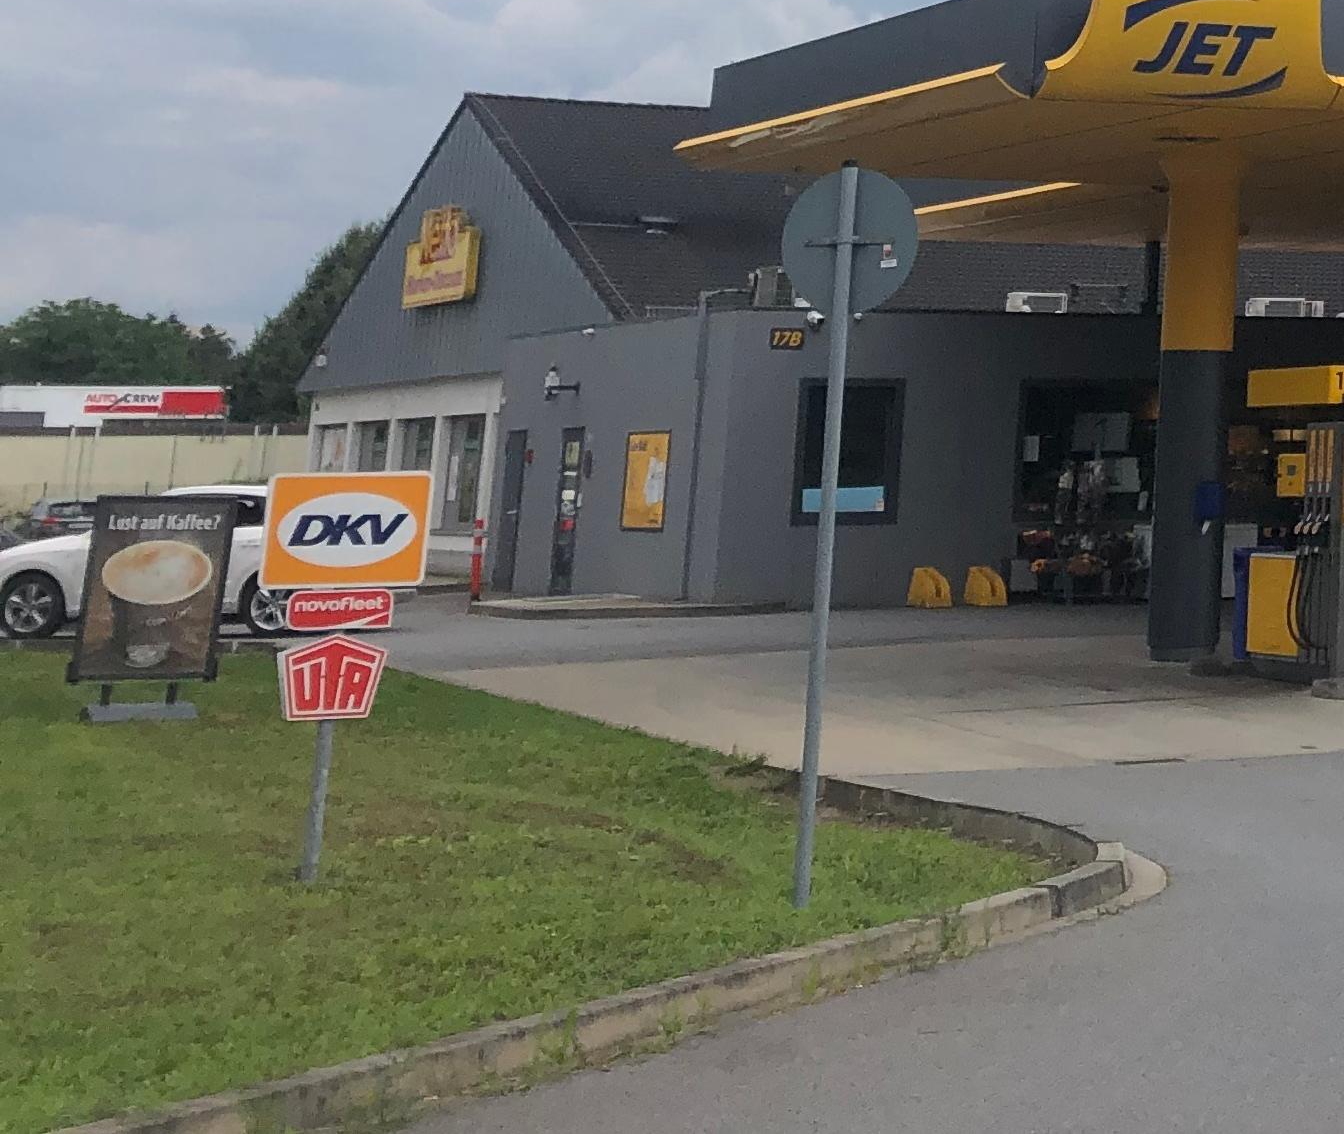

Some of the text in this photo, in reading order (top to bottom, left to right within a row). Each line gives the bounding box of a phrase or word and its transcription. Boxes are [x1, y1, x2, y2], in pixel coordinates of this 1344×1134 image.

[1132, 21, 1278, 77] JET
[1335, 372, 1344, 390] 1
[109, 514, 222, 530] Lust auf Kaffee?
[288, 513, 409, 546] DKV
[292, 642, 377, 710] UTA
